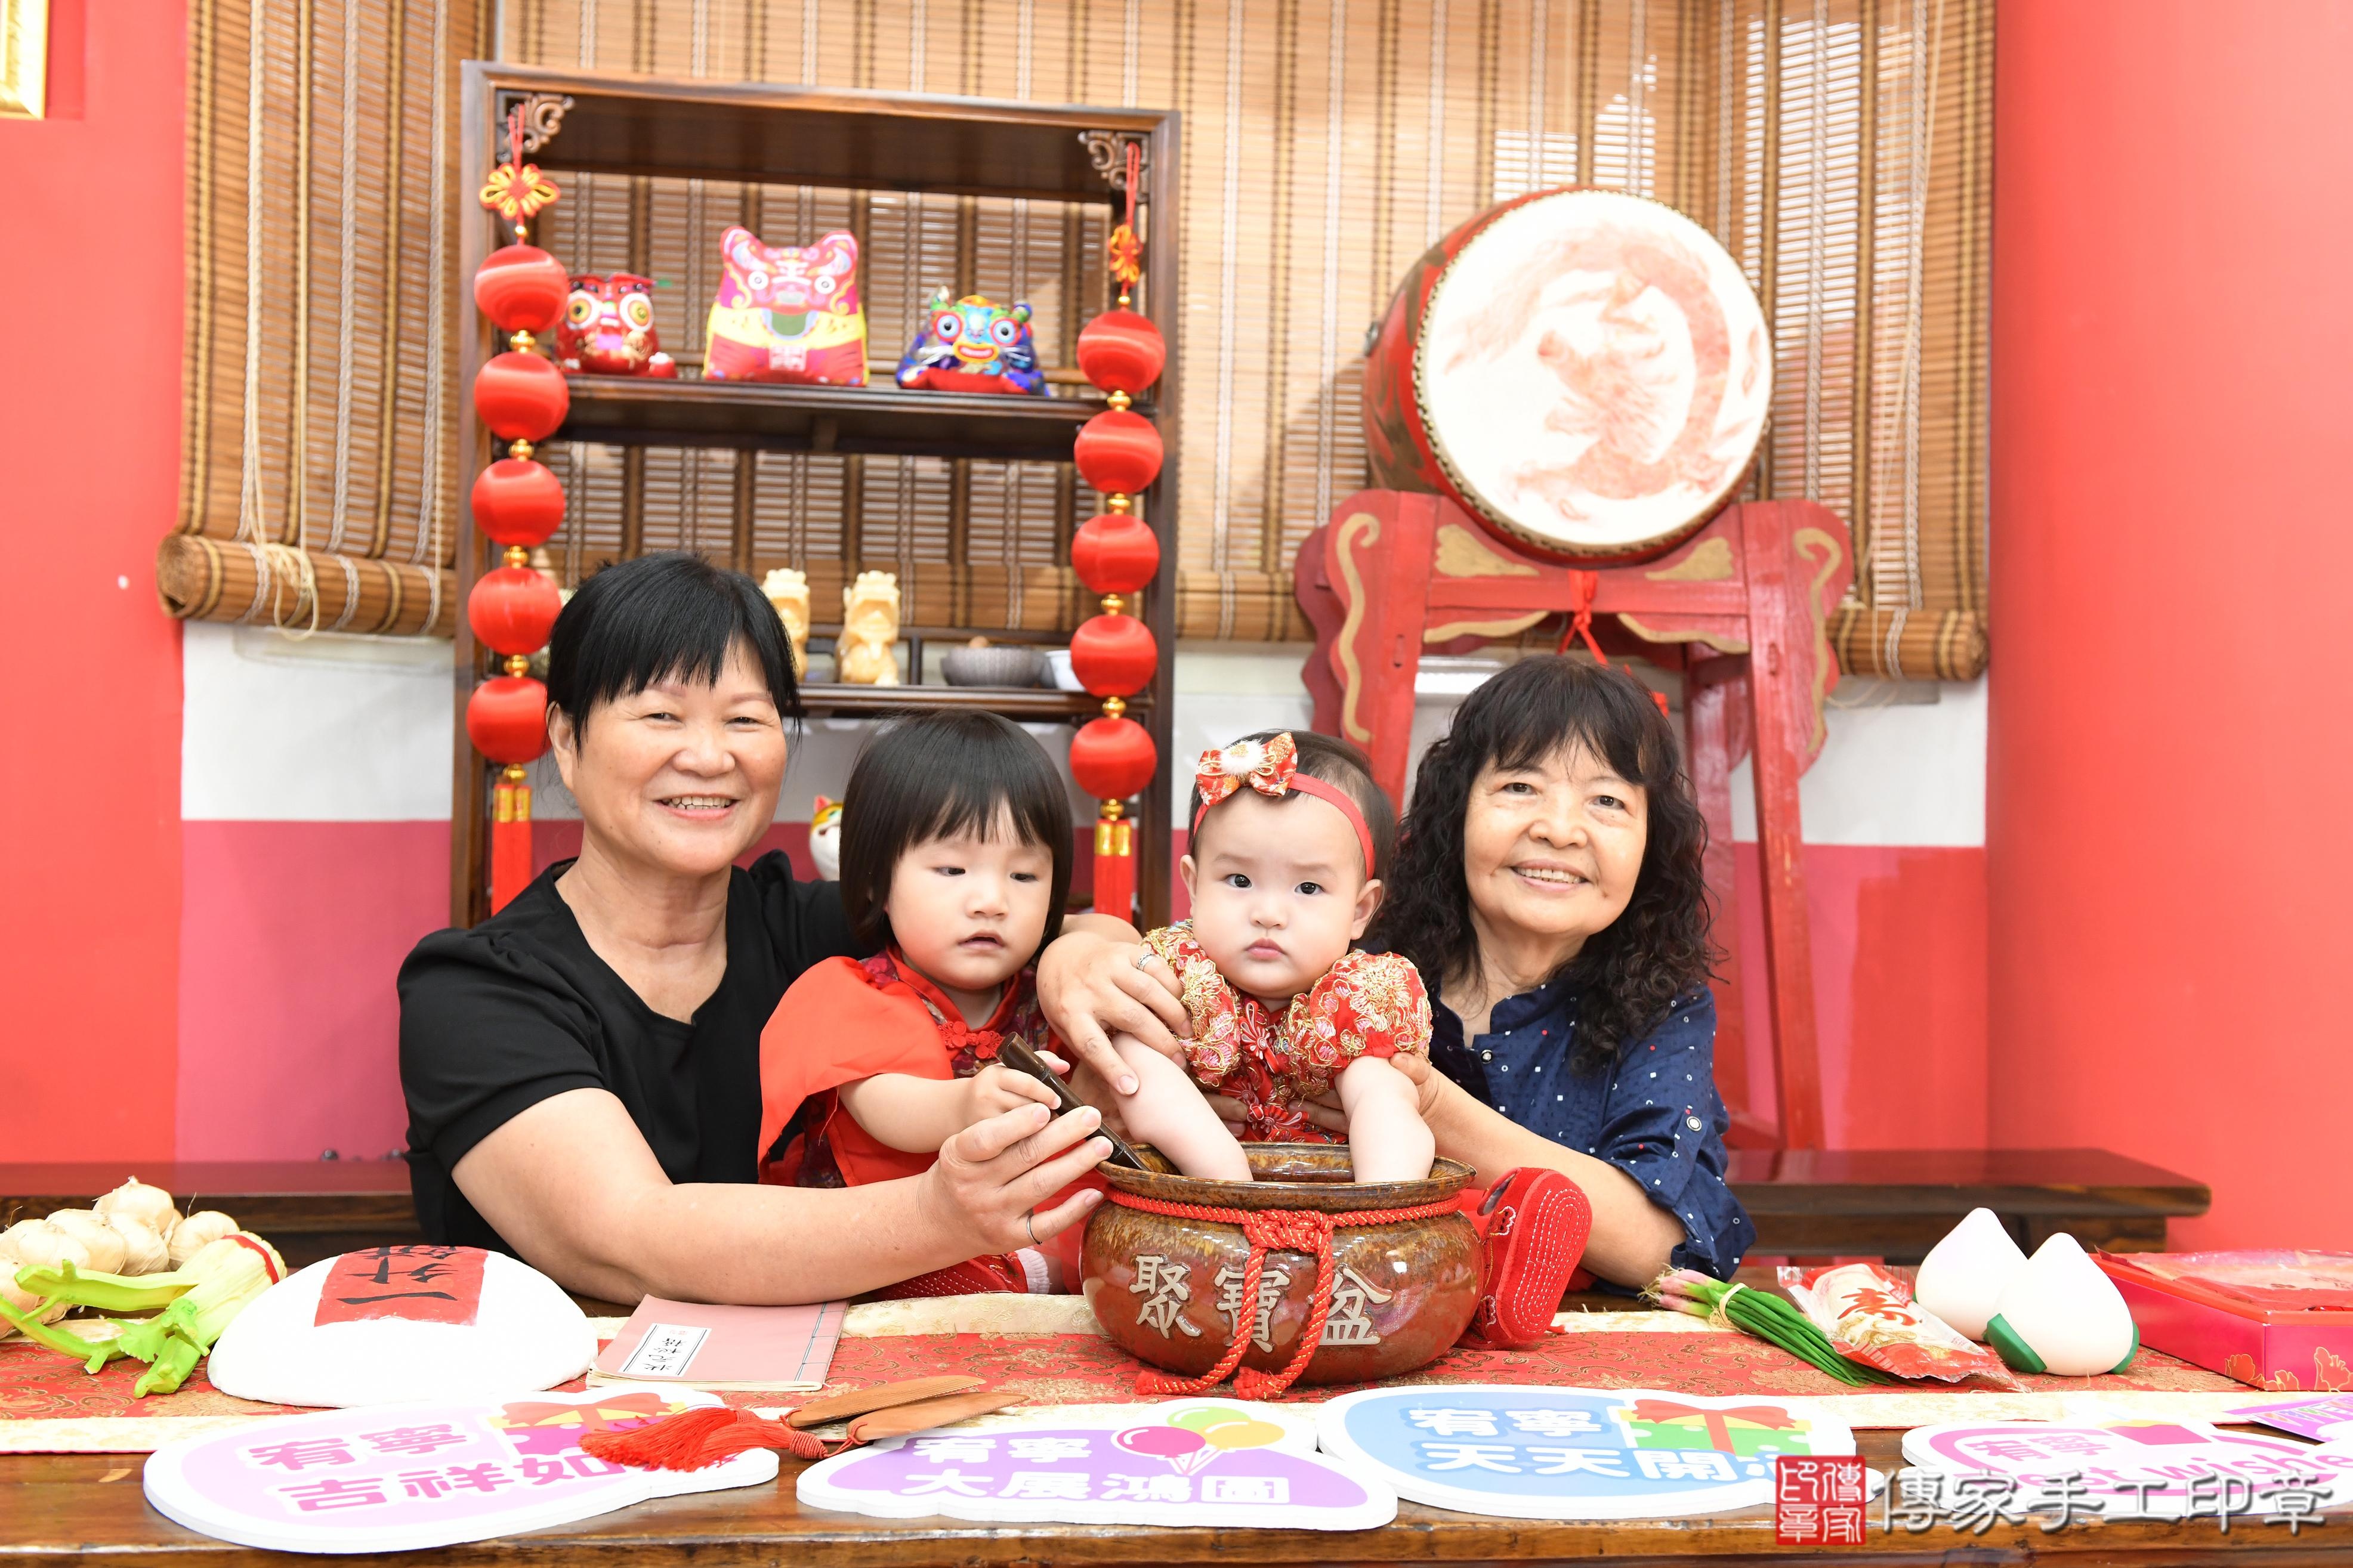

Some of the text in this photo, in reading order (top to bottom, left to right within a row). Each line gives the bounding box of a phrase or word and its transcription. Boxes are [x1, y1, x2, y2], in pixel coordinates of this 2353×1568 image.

[1129, 1252, 1393, 1353] 聚寶盆
[1409, 1409, 1601, 1436] 宥寧
[248, 1423, 467, 1471] 宥寧
[913, 1437, 1092, 1463] 宥寧
[279, 1455, 737, 1511] 吉祥如
[901, 1468, 1290, 1504] 大展鴻圖
